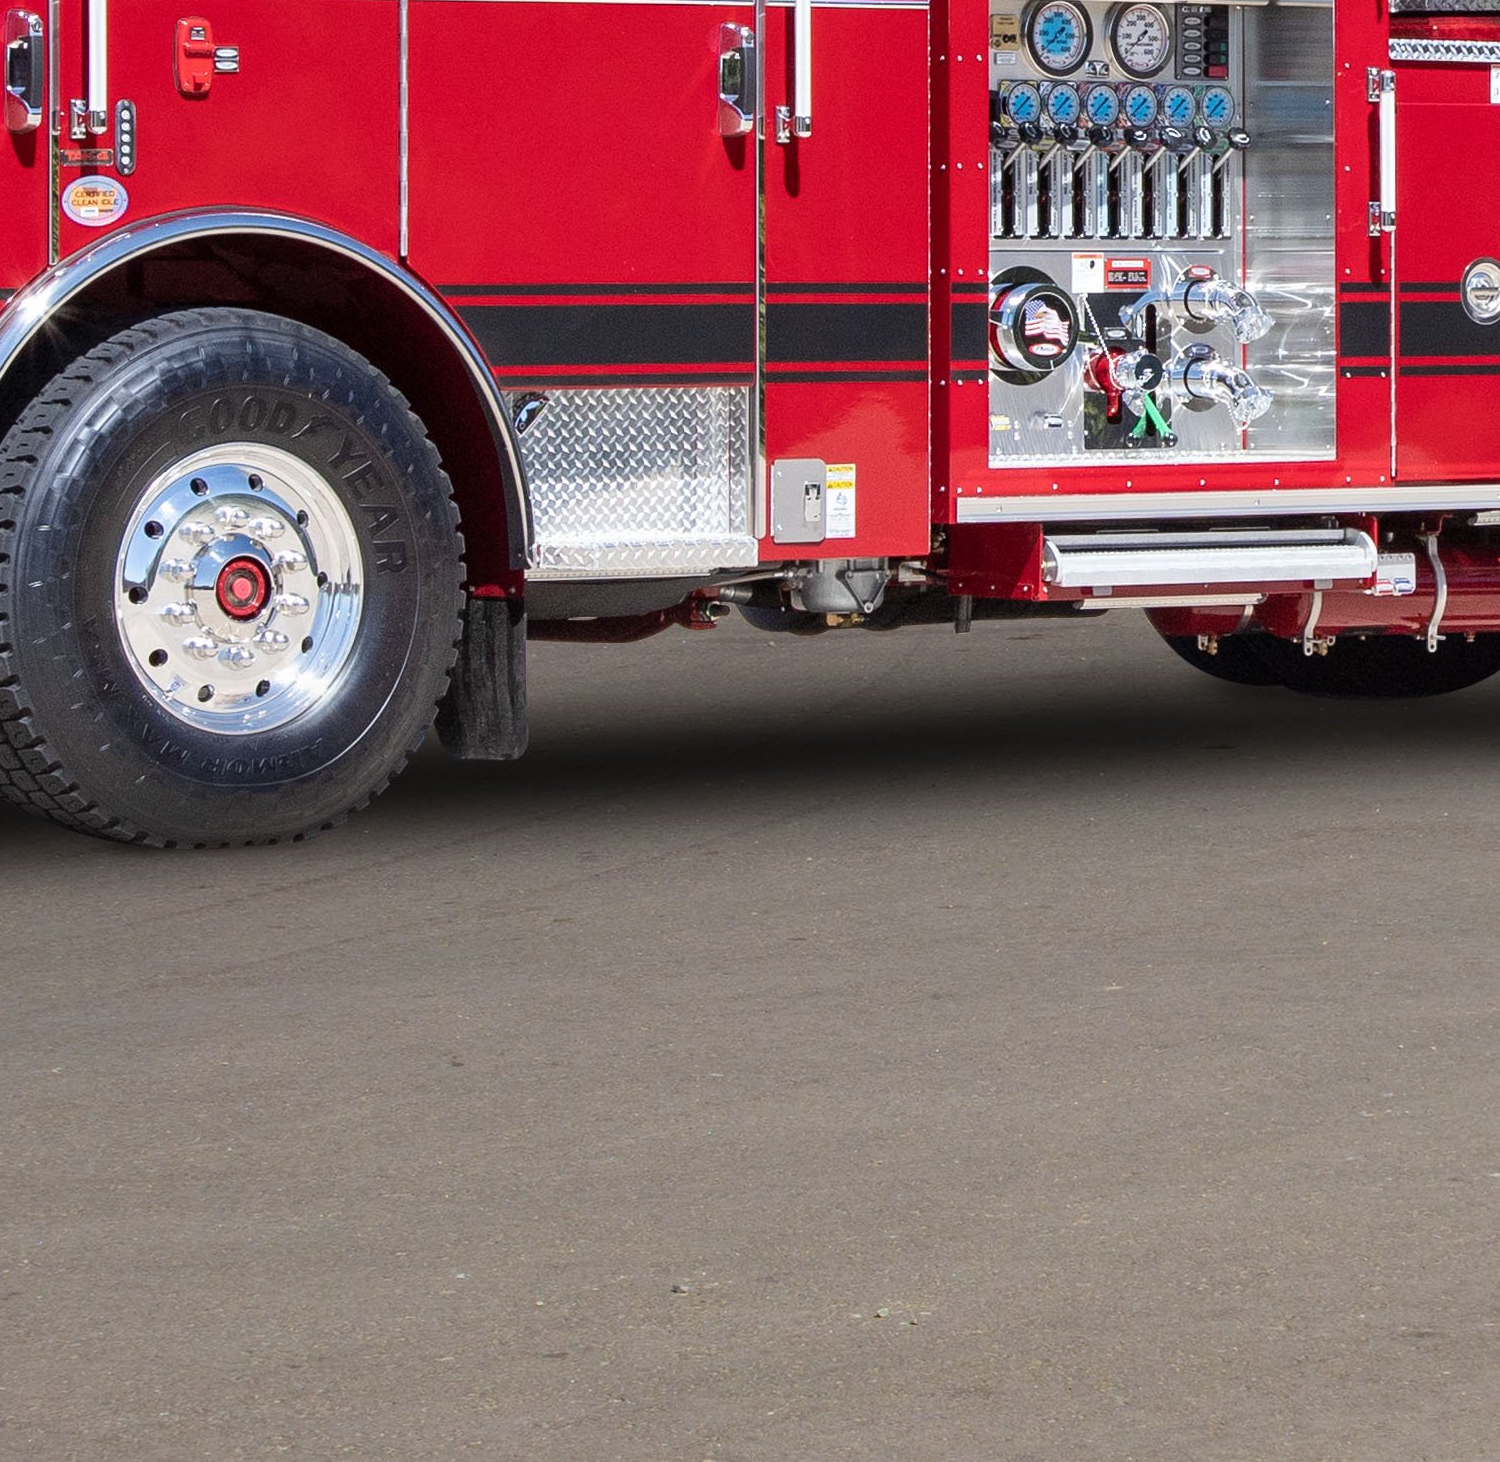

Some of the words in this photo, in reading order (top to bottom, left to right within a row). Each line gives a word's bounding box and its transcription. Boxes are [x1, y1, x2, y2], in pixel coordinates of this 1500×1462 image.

[74, 190, 115, 198] CERTIFIED
[71, 198, 98, 206] CLEAN
[101, 198, 119, 206] IDLE
[180, 394, 409, 575] GOODYEAR
